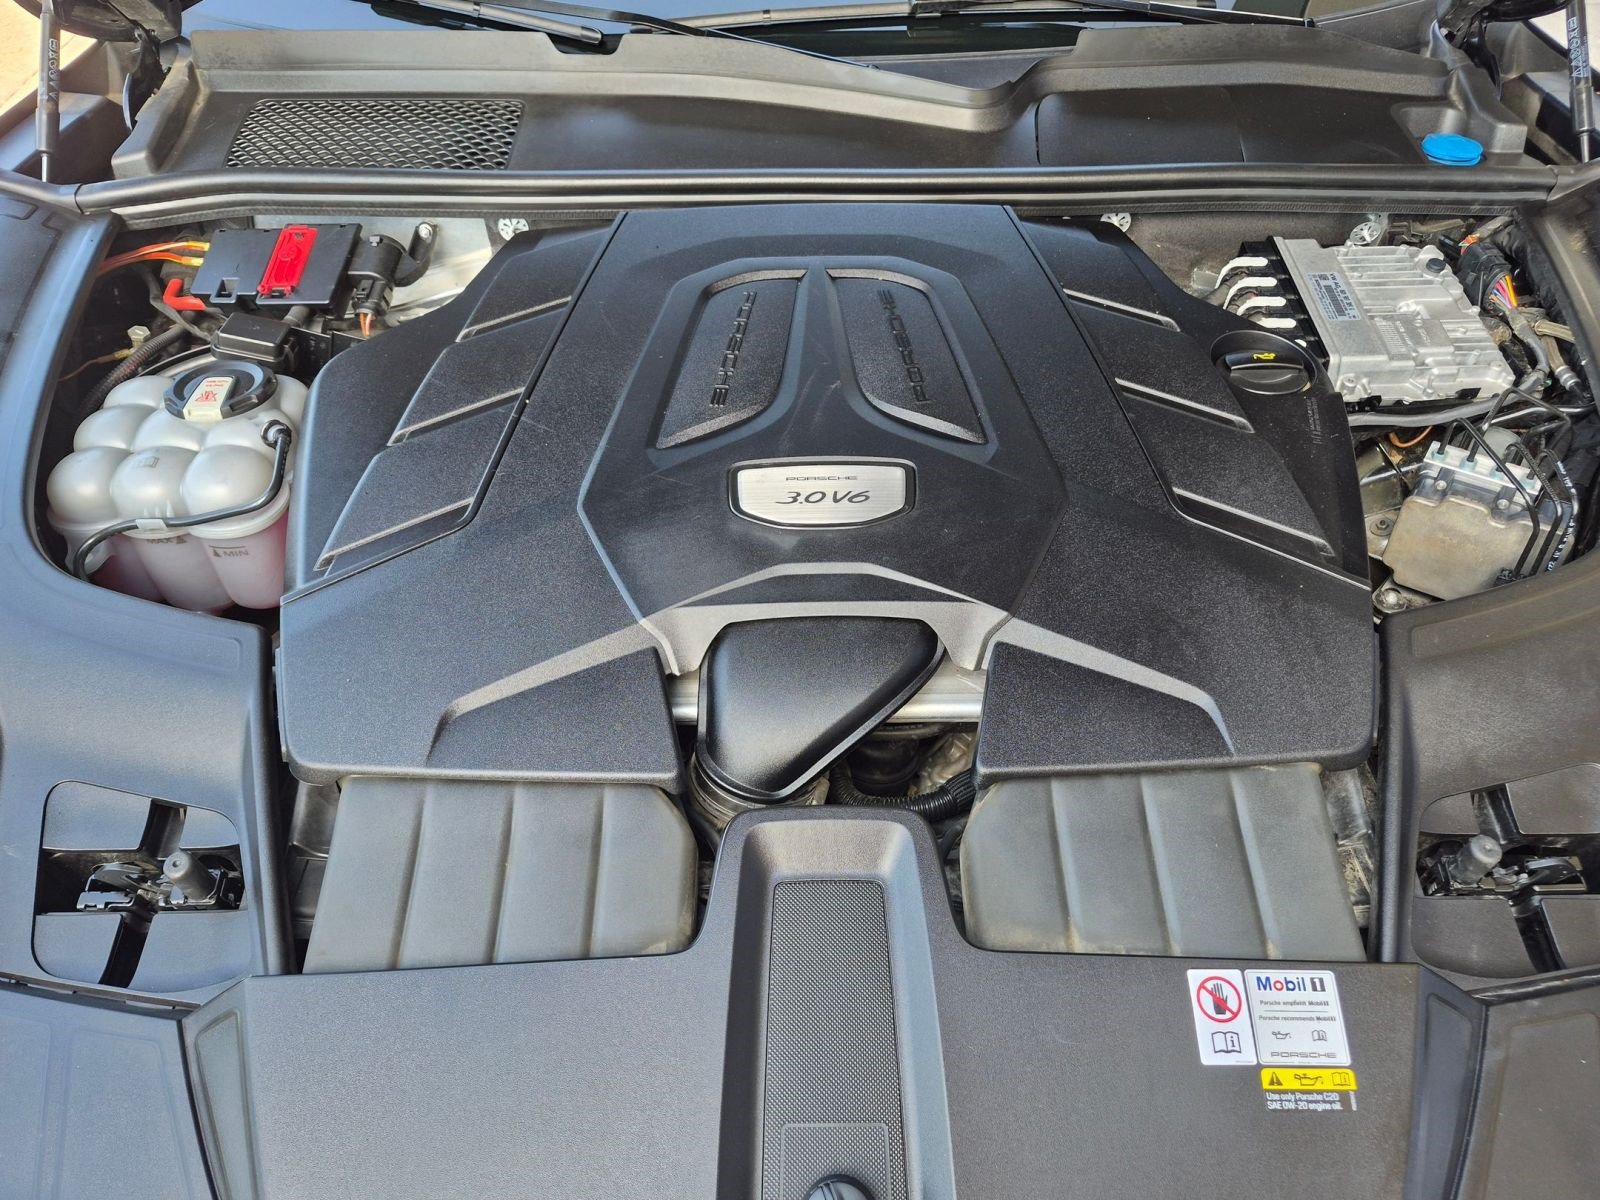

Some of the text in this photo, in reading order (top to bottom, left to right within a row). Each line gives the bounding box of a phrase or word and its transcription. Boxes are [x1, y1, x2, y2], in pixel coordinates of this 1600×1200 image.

[709, 291, 757, 407] PORSCHE
[877, 289, 930, 403] PORSCHE
[775, 490, 871, 504] 3.0 V6
[222, 549, 249, 558] MIN
[1256, 976, 1327, 992] Mobil 1
[1271, 1051, 1337, 1059] PORSCHE
[1266, 1091, 1280, 1100] Use
[1280, 1091, 1295, 1101] only
[1295, 1092, 1323, 1101] Porsche
[1267, 1101, 1282, 1110] SAE
[1308, 1102, 1332, 1112] engine
